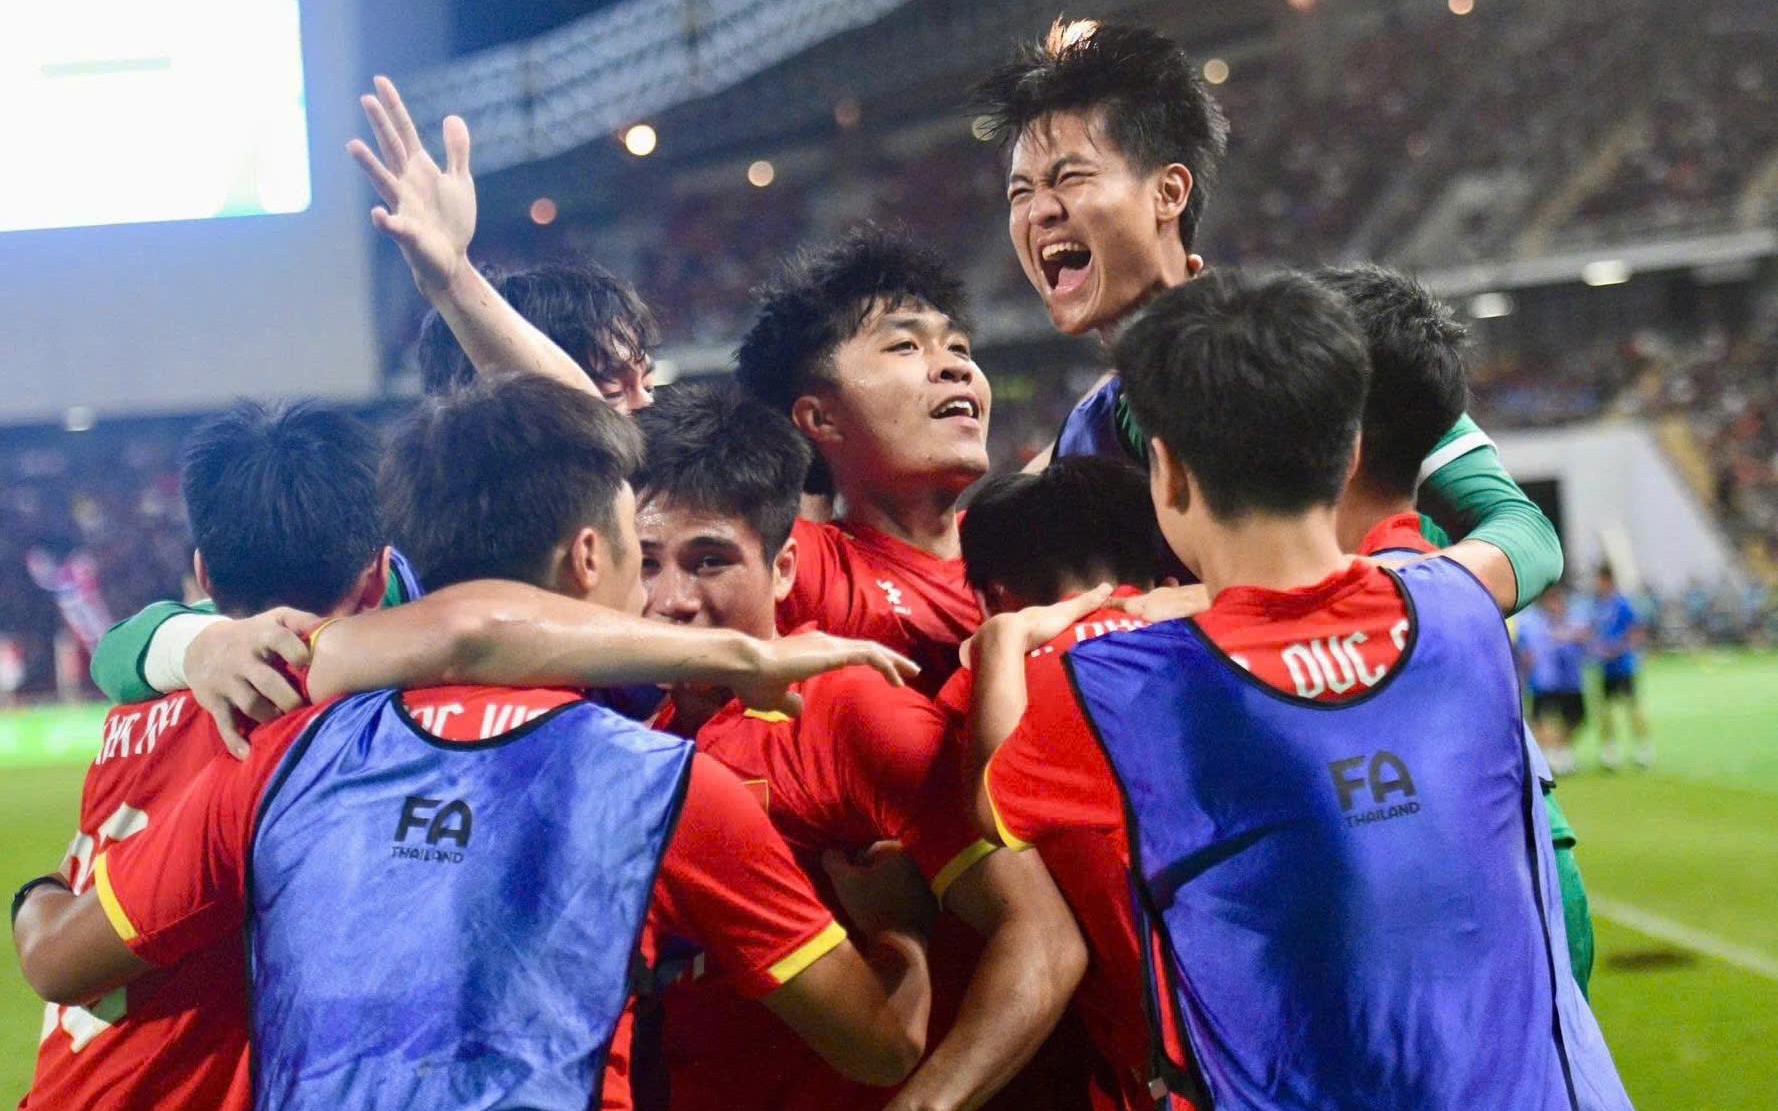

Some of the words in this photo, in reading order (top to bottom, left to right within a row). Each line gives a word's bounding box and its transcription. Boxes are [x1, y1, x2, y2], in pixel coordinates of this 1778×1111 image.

[1328, 750, 1416, 812] FA
[394, 796, 472, 848] FA
[1344, 802, 1420, 827] THAILAND
[392, 846, 464, 864] THAILAND
